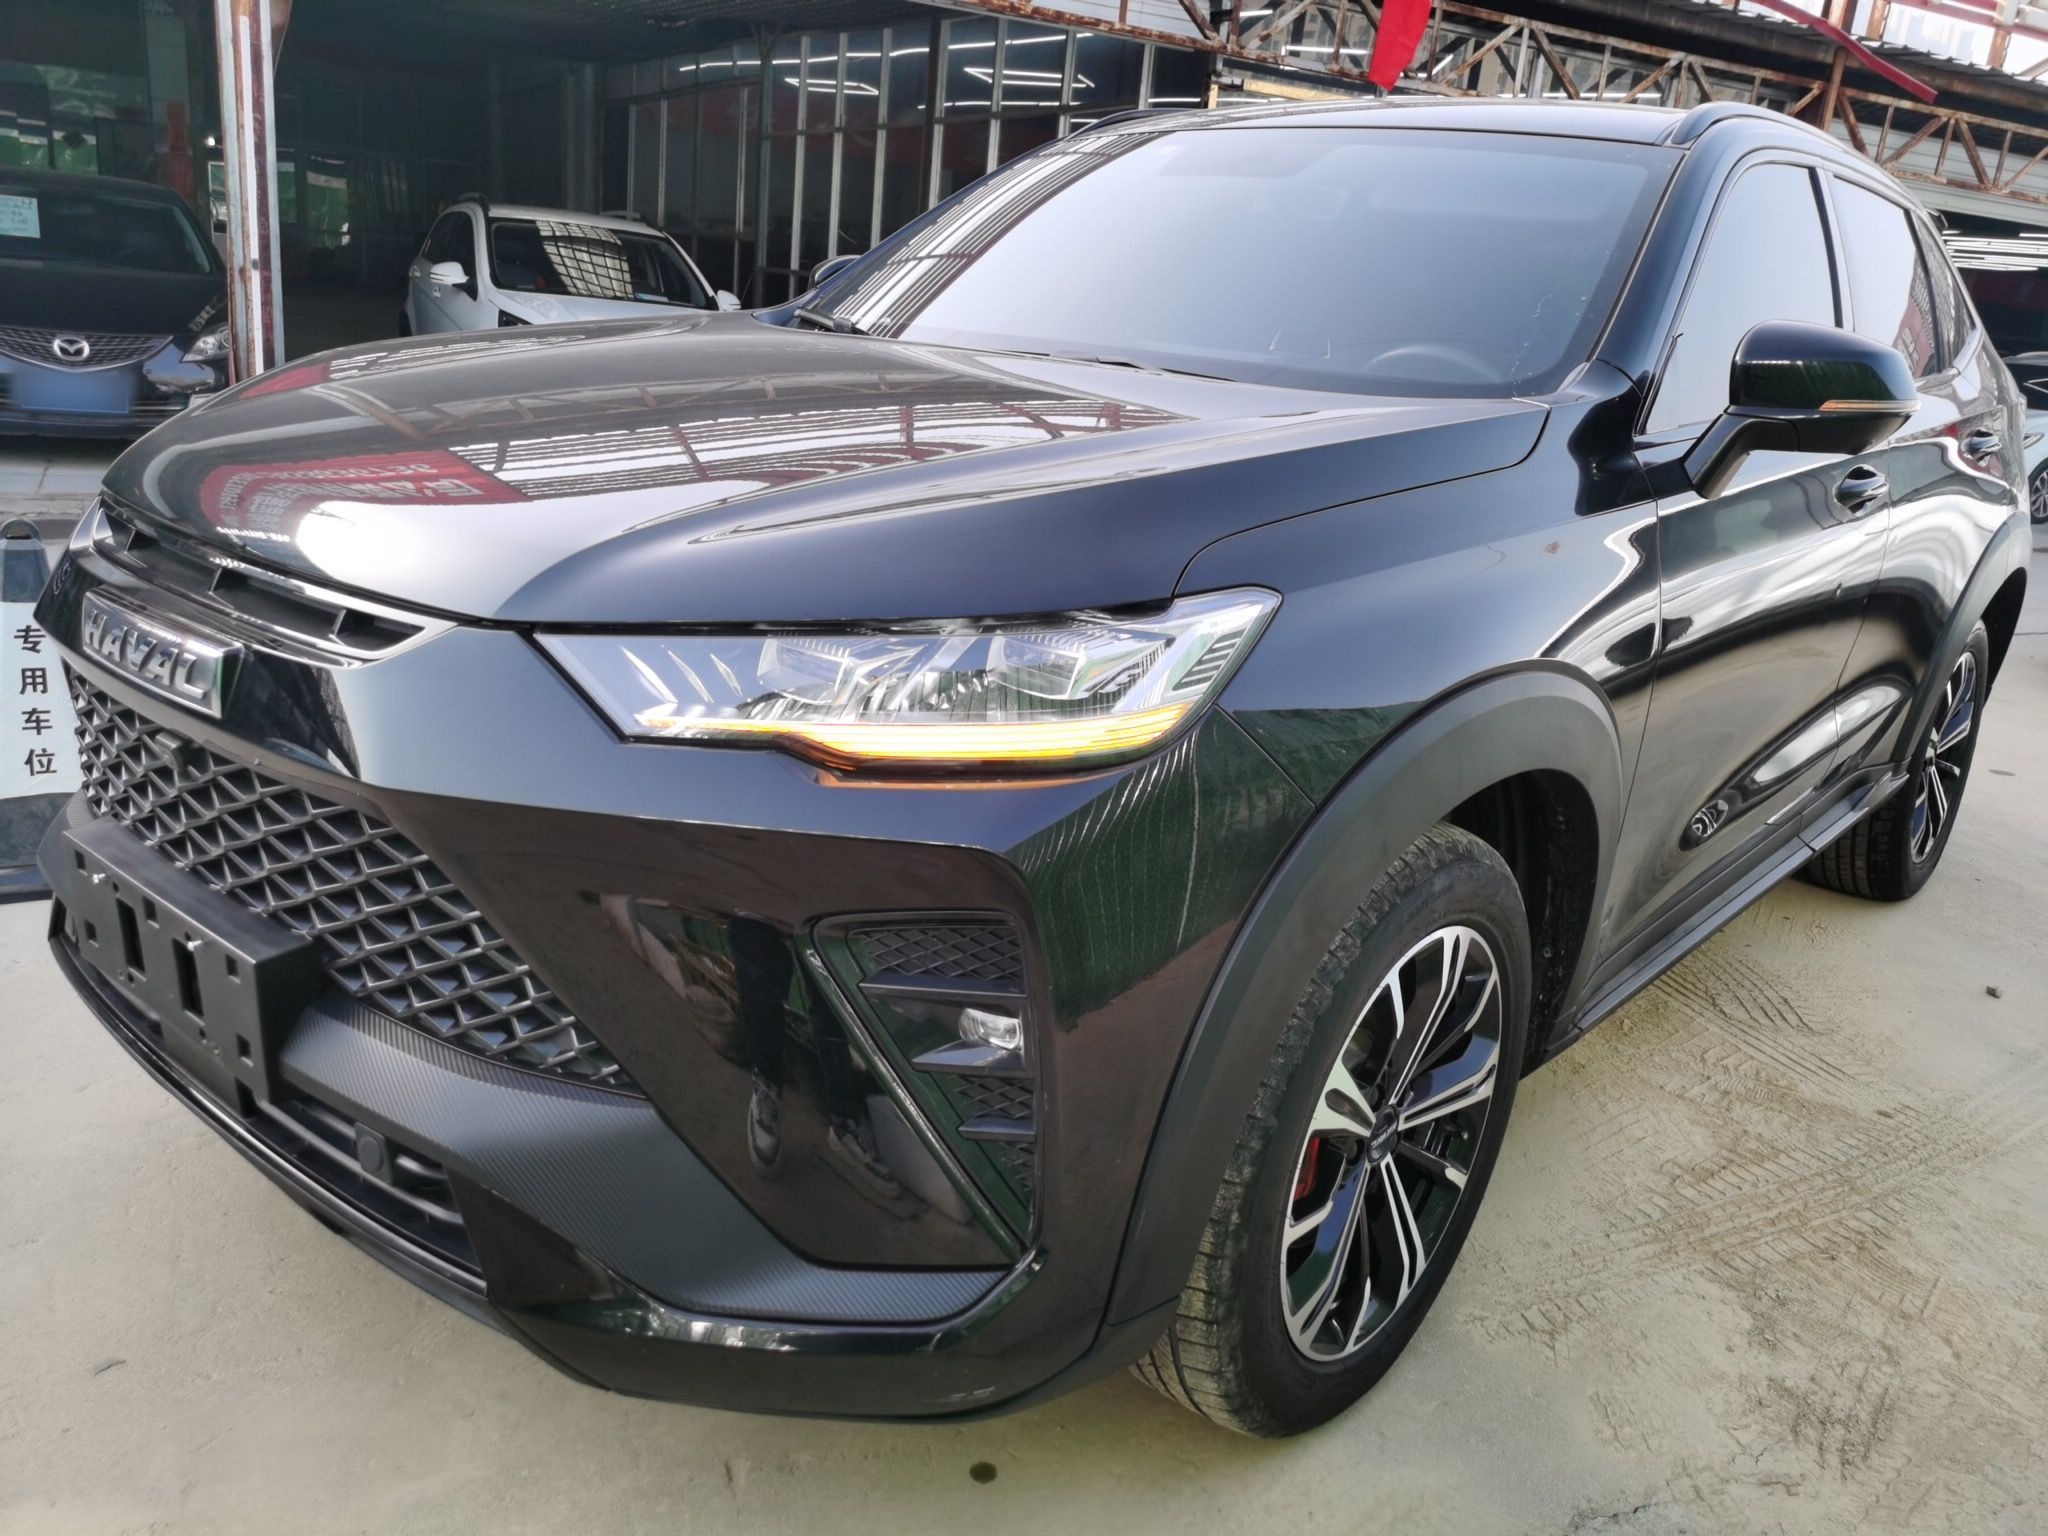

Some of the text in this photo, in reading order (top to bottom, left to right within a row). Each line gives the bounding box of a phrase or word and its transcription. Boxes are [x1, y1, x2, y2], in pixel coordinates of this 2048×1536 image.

[13, 624, 58, 777] 专用车位
[85, 609, 206, 700] HAVAL
